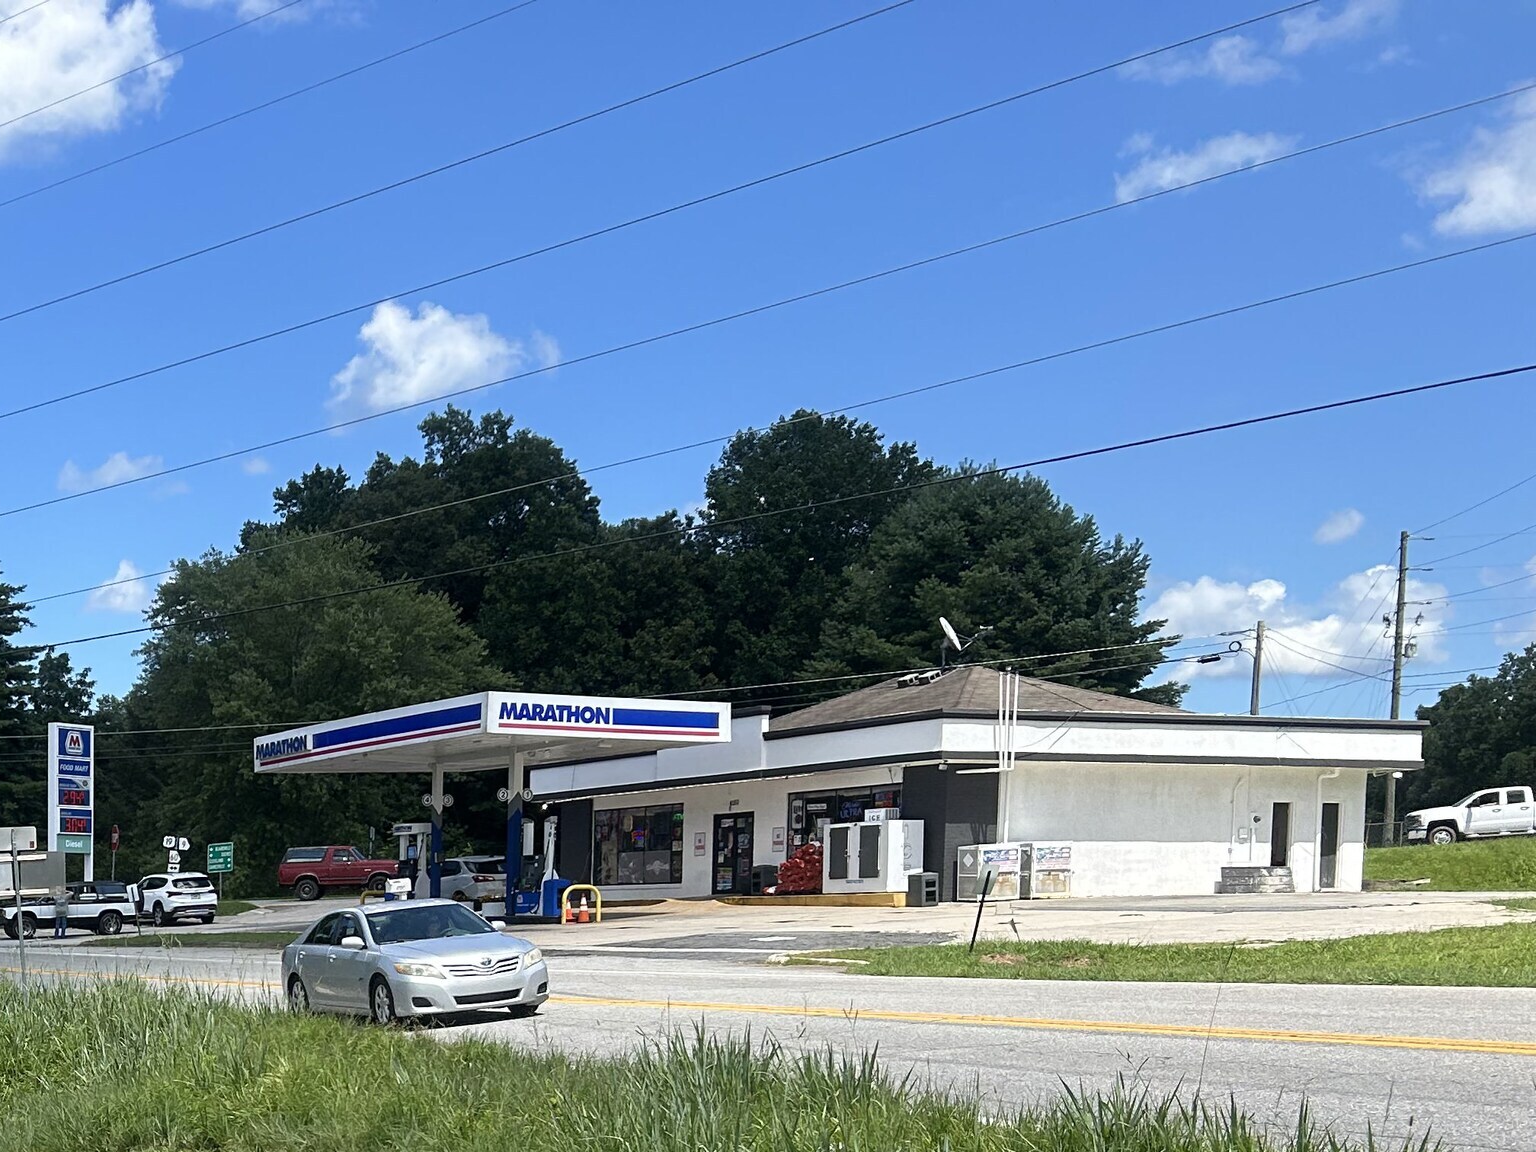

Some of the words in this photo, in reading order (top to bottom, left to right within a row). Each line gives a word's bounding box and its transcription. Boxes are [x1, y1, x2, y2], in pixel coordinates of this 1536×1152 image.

[498, 701, 611, 726] MARATHON
[255, 734, 308, 760] MARATHON
[65, 840, 83, 848] Diesel
